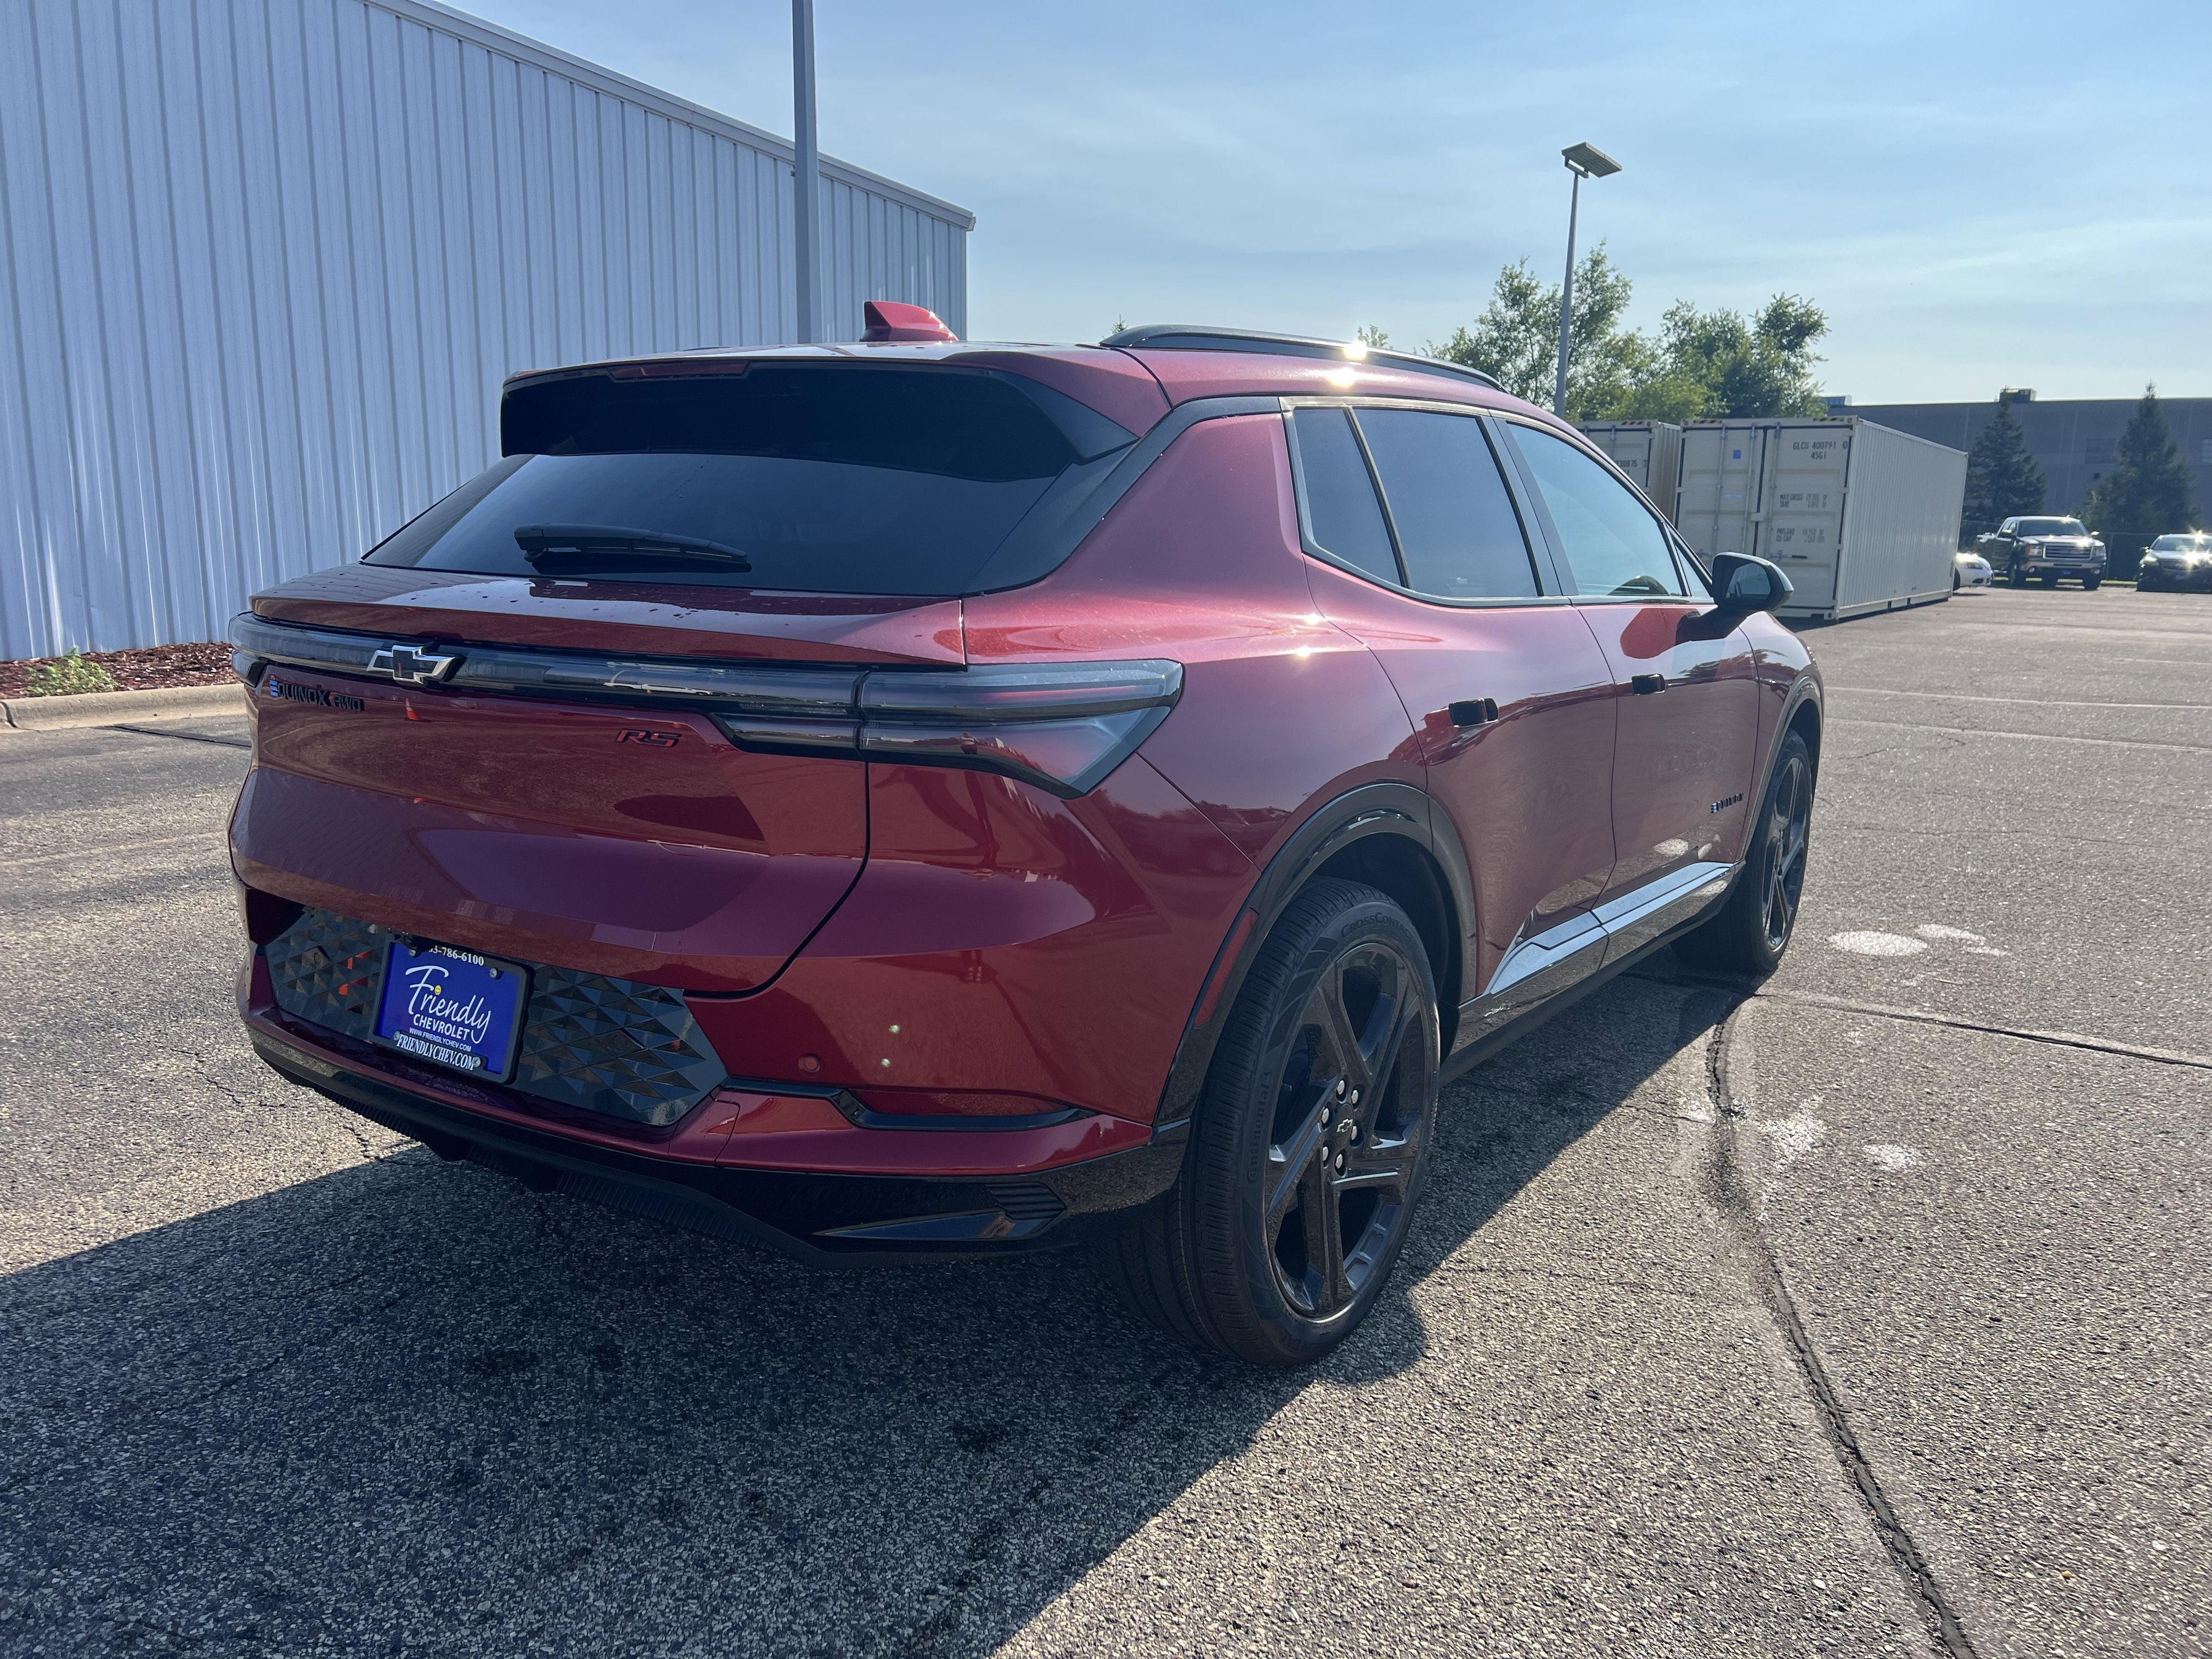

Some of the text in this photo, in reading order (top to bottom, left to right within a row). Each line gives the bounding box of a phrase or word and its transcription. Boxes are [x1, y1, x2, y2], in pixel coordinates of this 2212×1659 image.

[1812, 441, 1836, 449] 400791
[269, 680, 330, 707] EQUINOX
[614, 728, 682, 747] RS
[428, 945, 484, 966] 3-786-6100
[405, 965, 491, 1044] Friendly
[409, 1027, 472, 1052] WWW.FRIENDLYCHEV.COM
[413, 1013, 470, 1041] CHEVROLET
[397, 1034, 475, 1070] FRIENDLYCHEV.COM
